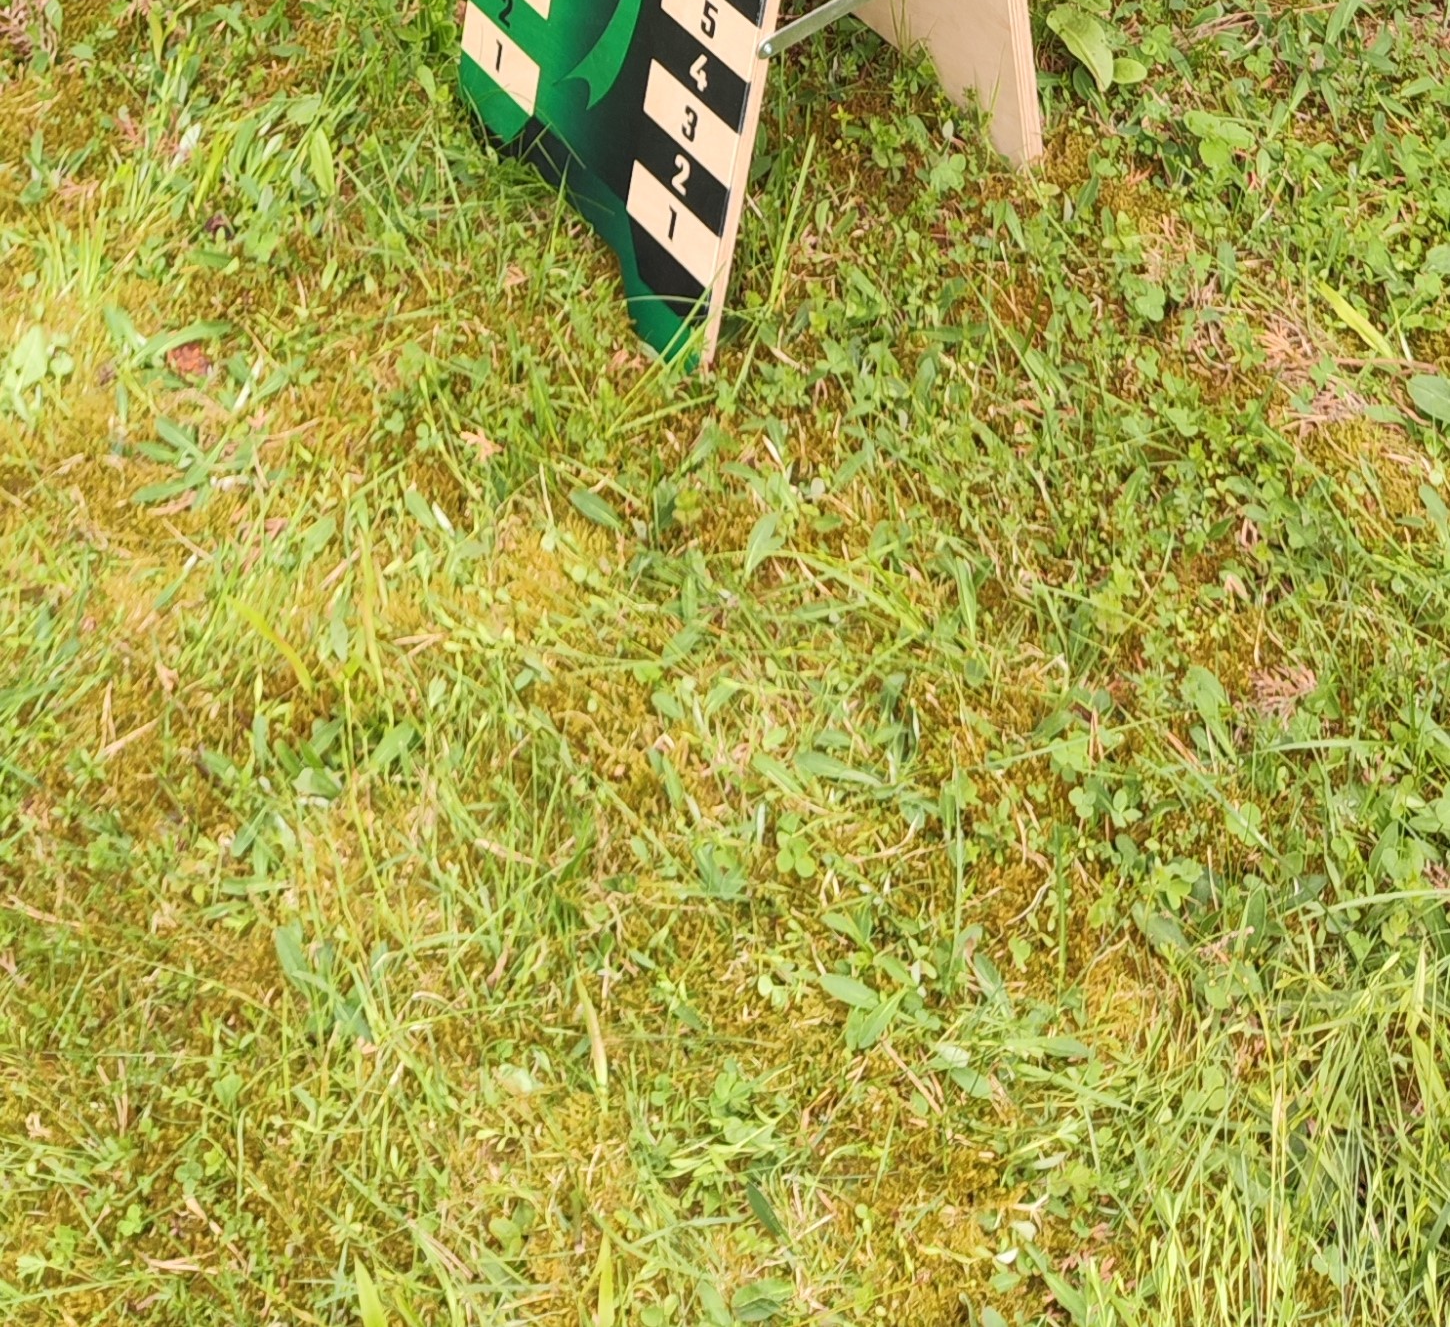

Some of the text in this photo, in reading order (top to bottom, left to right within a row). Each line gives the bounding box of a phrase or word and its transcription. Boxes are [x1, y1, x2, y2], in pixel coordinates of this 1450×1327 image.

[700, 0, 718, 40] 5
[496, 39, 503, 73] 1
[690, 55, 708, 92] 4
[682, 105, 698, 143] 3
[672, 155, 691, 195] 2
[668, 205, 677, 241] 1
